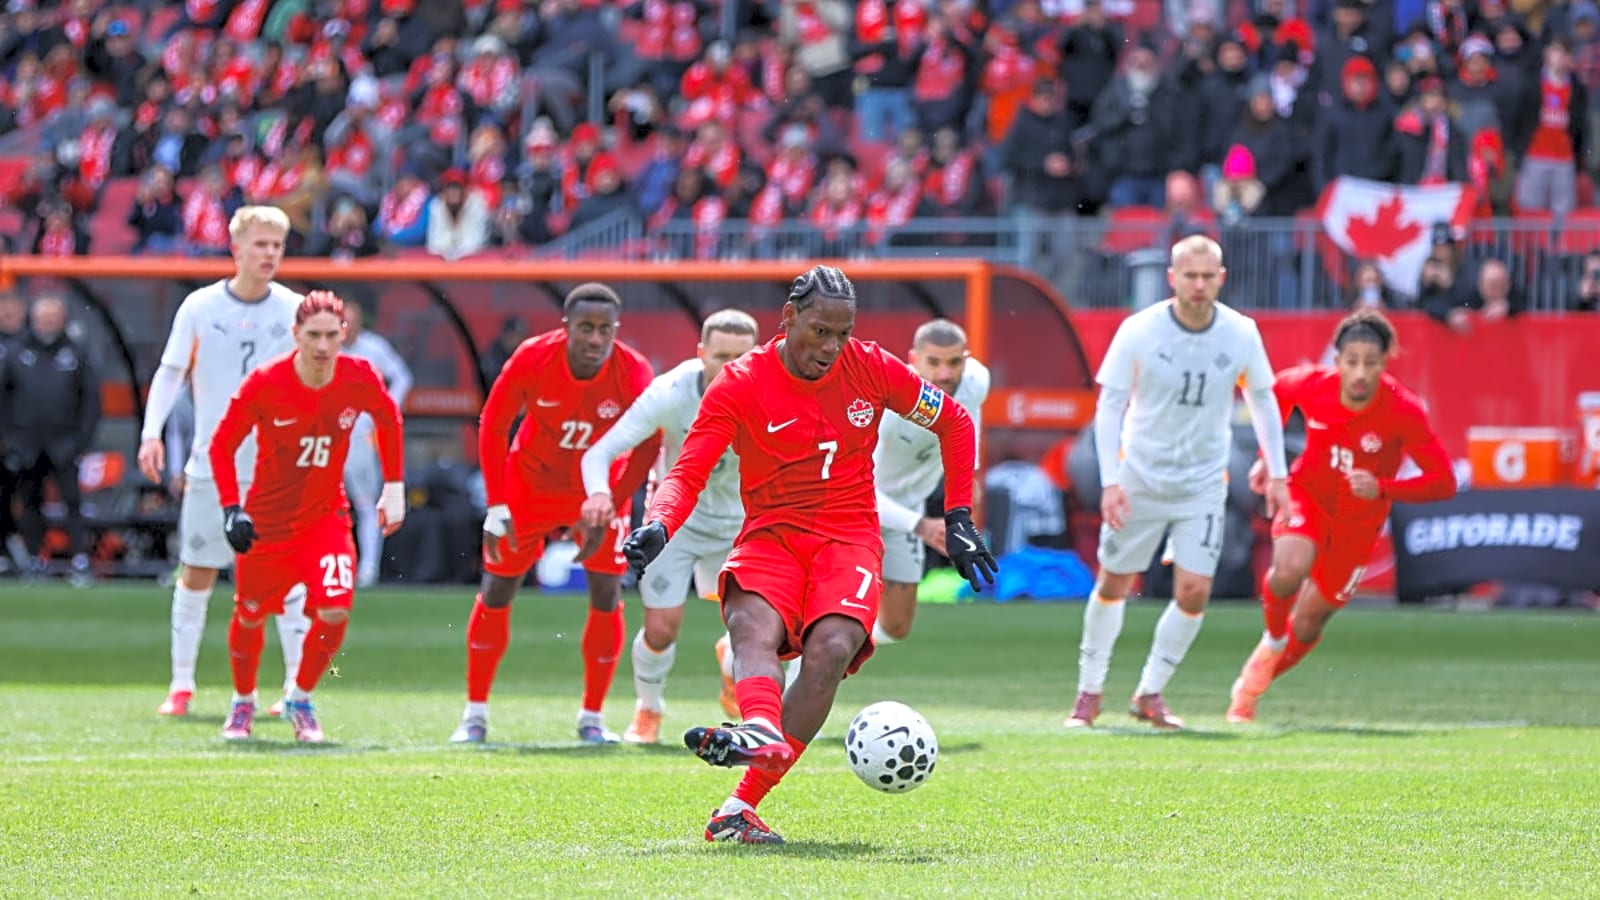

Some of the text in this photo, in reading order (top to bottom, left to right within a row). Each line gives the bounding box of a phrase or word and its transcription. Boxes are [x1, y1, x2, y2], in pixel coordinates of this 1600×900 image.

[240, 340, 255, 376] 7
[1177, 370, 1206, 408] 11
[295, 435, 332, 468] 26
[559, 420, 593, 450] 22
[817, 440, 838, 480] 7
[1329, 444, 1354, 478] 19
[1494, 441, 1526, 482] G
[1405, 513, 1583, 556] GATORADE
[319, 553, 354, 590] 26
[855, 565, 873, 600] 7
